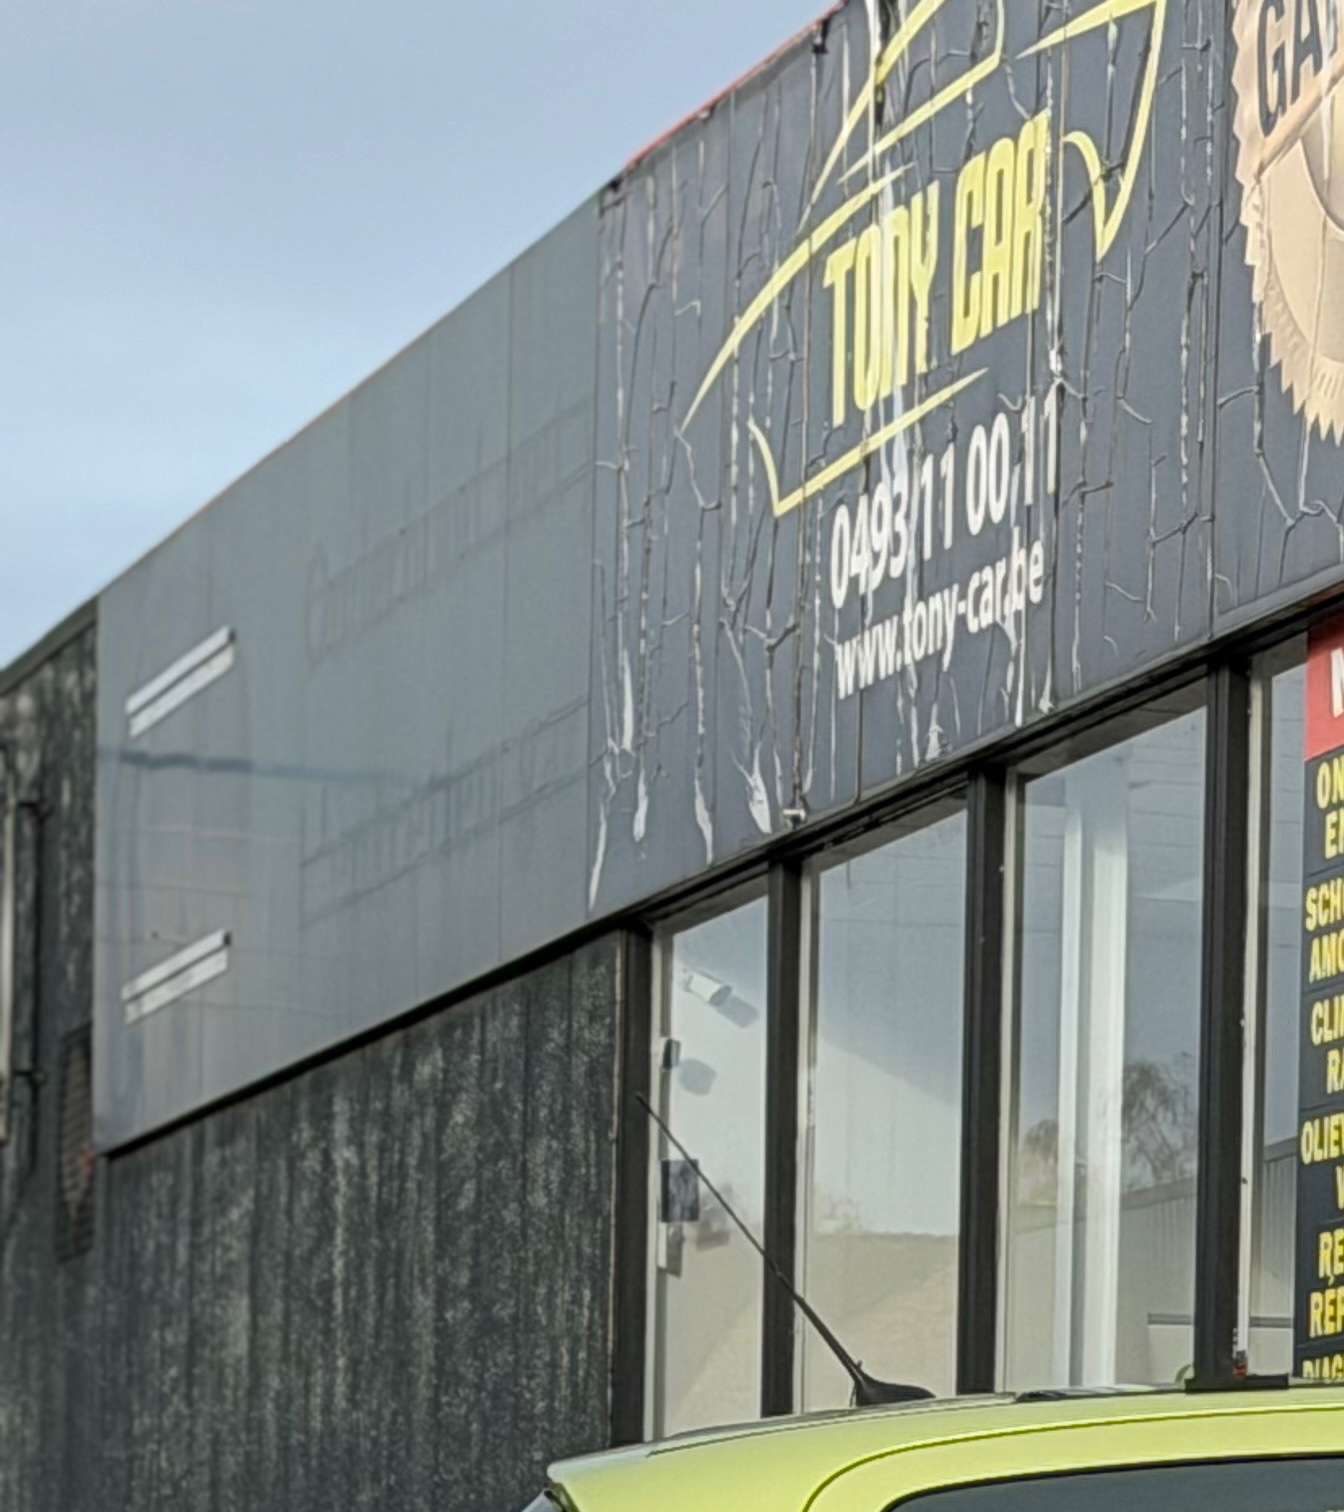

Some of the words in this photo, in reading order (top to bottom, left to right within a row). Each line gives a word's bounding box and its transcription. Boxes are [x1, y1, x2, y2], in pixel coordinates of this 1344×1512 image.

[823, 180, 940, 428] TONY
[951, 108, 1050, 355] CAR
[966, 412, 1010, 535] 00
[835, 526, 1044, 699] www.tony-car.be
